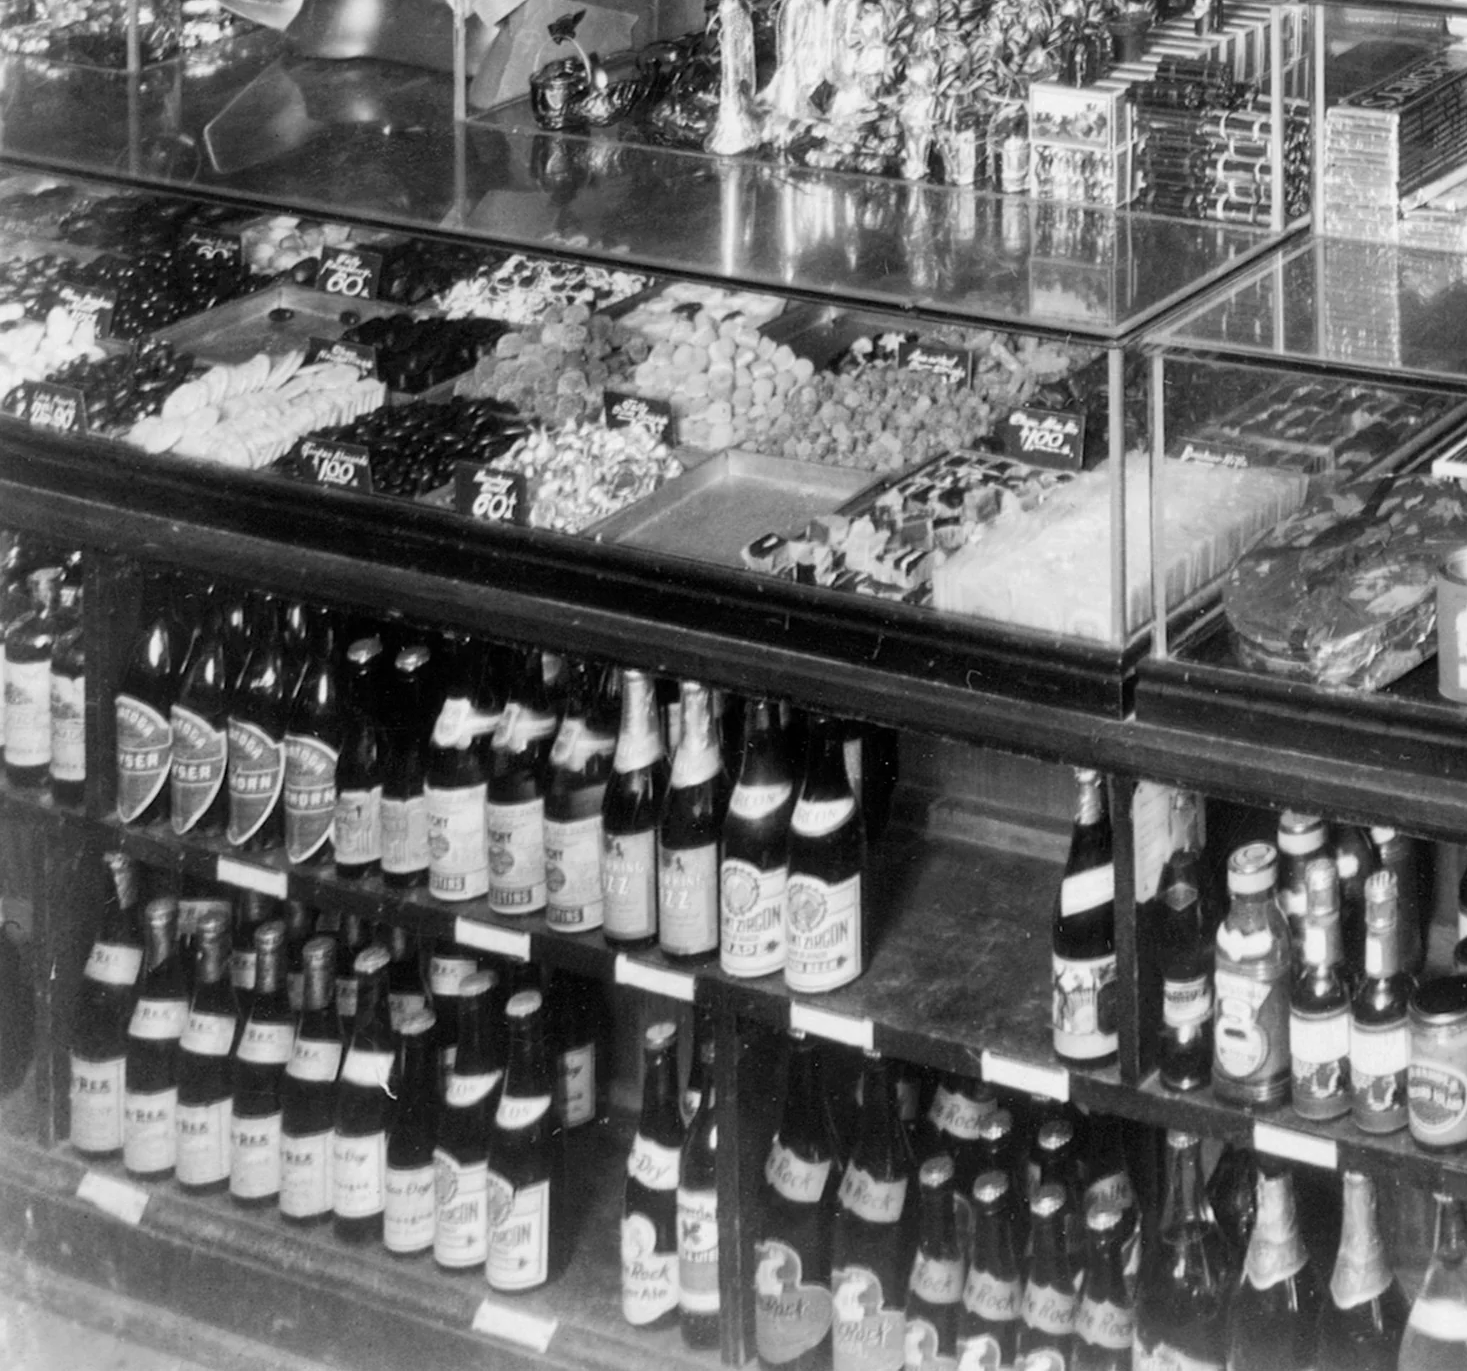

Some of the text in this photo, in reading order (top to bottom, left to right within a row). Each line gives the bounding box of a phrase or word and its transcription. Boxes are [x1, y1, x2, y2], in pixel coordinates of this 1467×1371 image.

[119, 753, 160, 769] YSER
[173, 764, 213, 781] YSER
[286, 790, 336, 807] HORN
